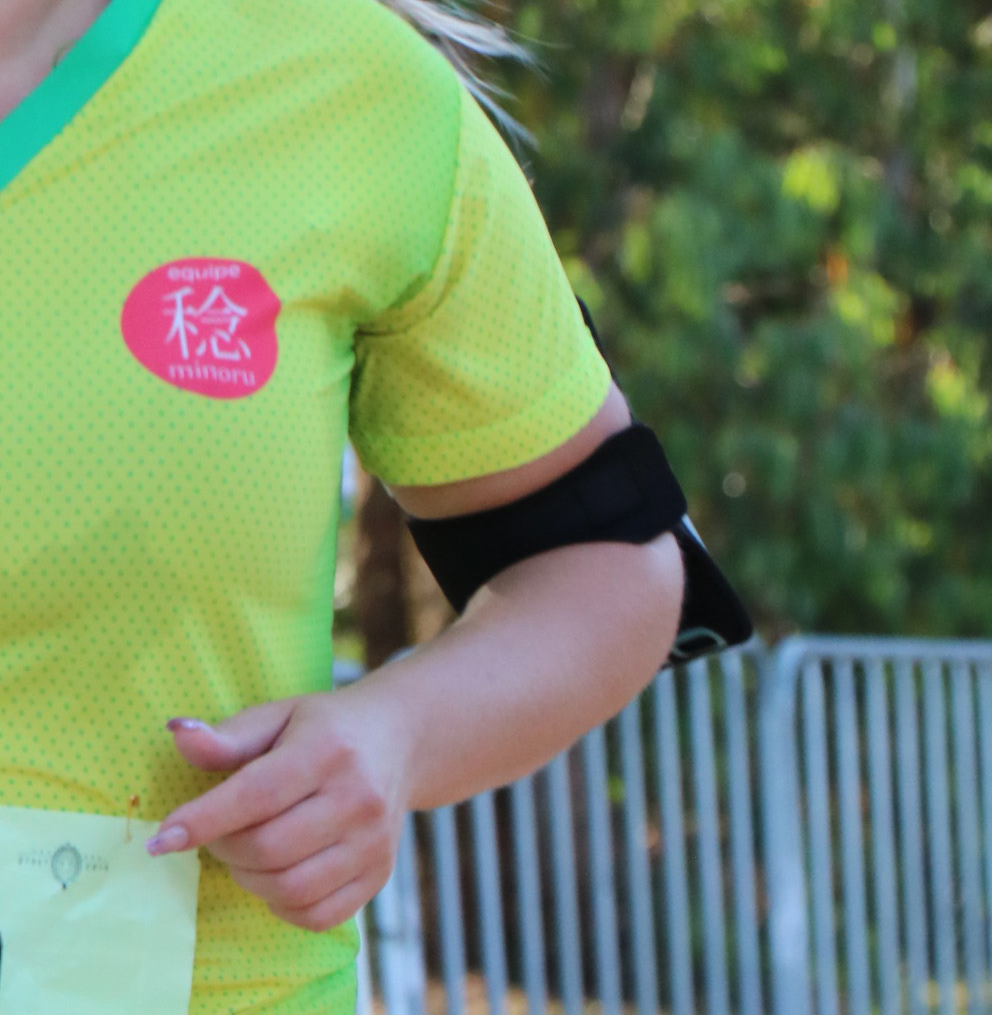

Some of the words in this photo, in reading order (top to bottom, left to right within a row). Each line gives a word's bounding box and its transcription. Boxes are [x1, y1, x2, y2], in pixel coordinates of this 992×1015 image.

[166, 265, 241, 283] equipe
[162, 286, 251, 361] 稔
[168, 361, 256, 386] minoru
